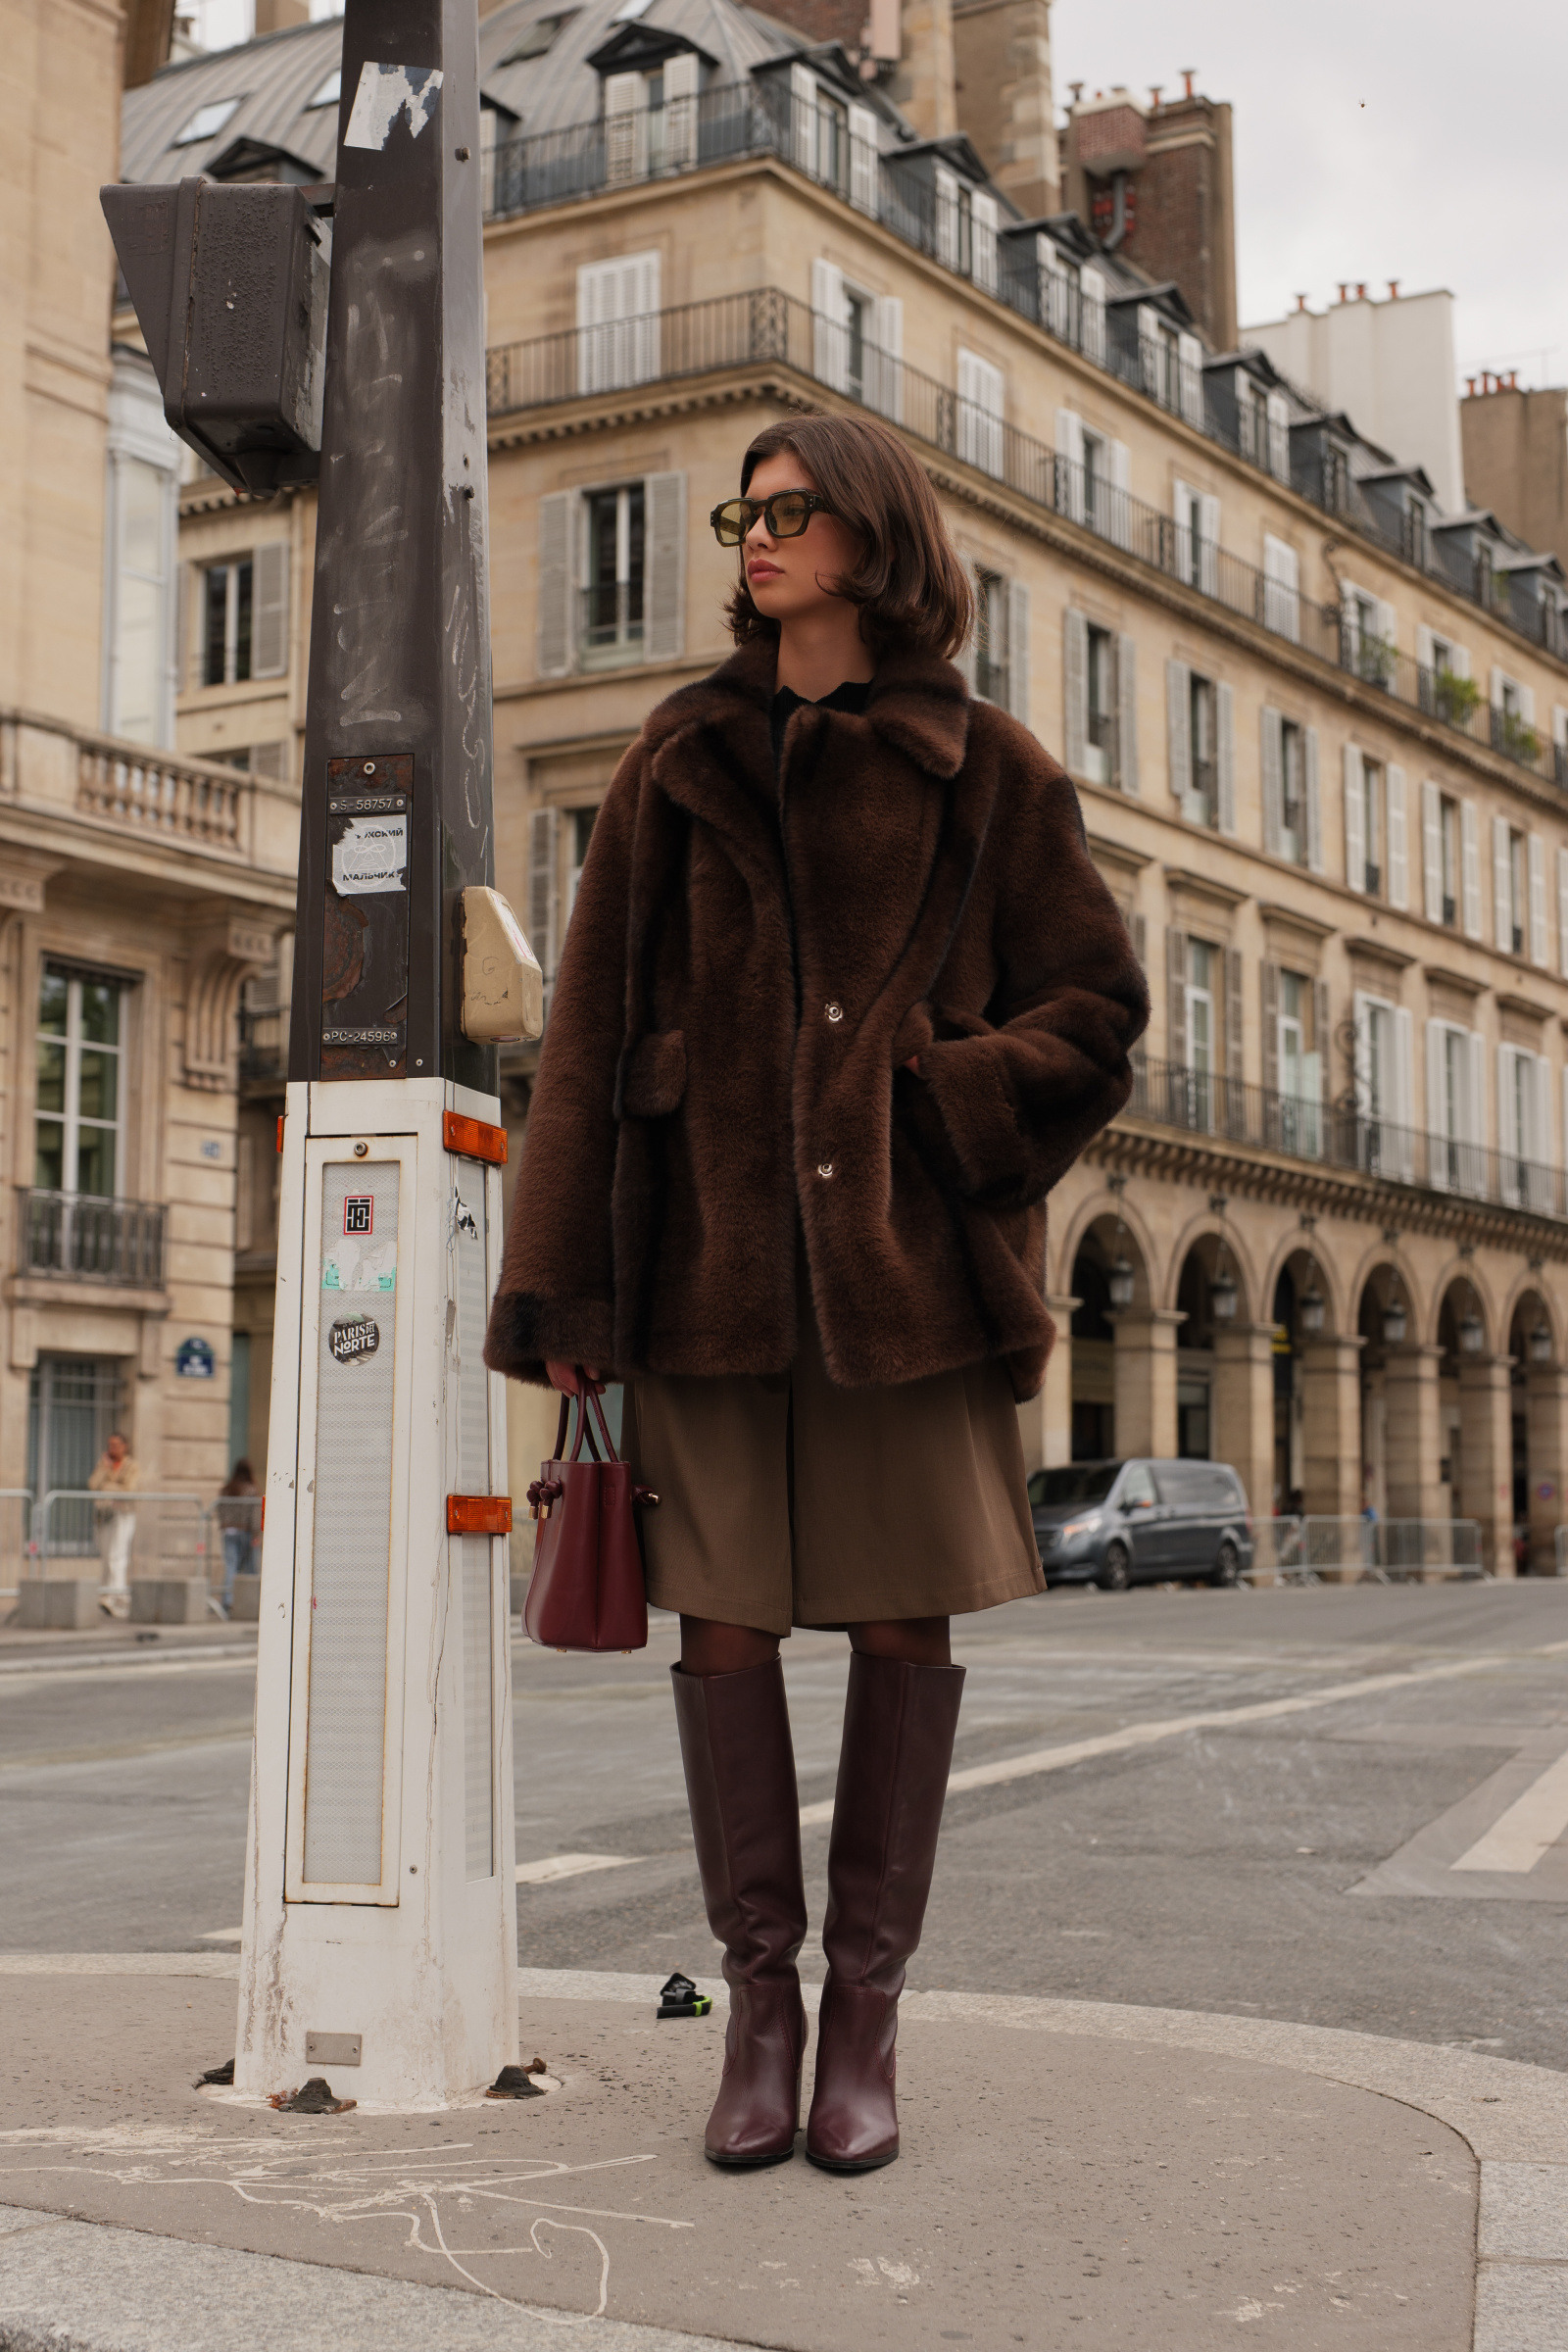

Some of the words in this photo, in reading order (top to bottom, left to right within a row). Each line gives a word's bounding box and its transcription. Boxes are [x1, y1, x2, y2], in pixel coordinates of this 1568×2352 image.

[339, 798, 393, 811] S-58757
[331, 1030, 391, 1043] PC-24596
[334, 1323, 366, 1344] PARIS
[366, 1323, 375, 1335] DEL
[334, 1333, 375, 1357] NORTE
